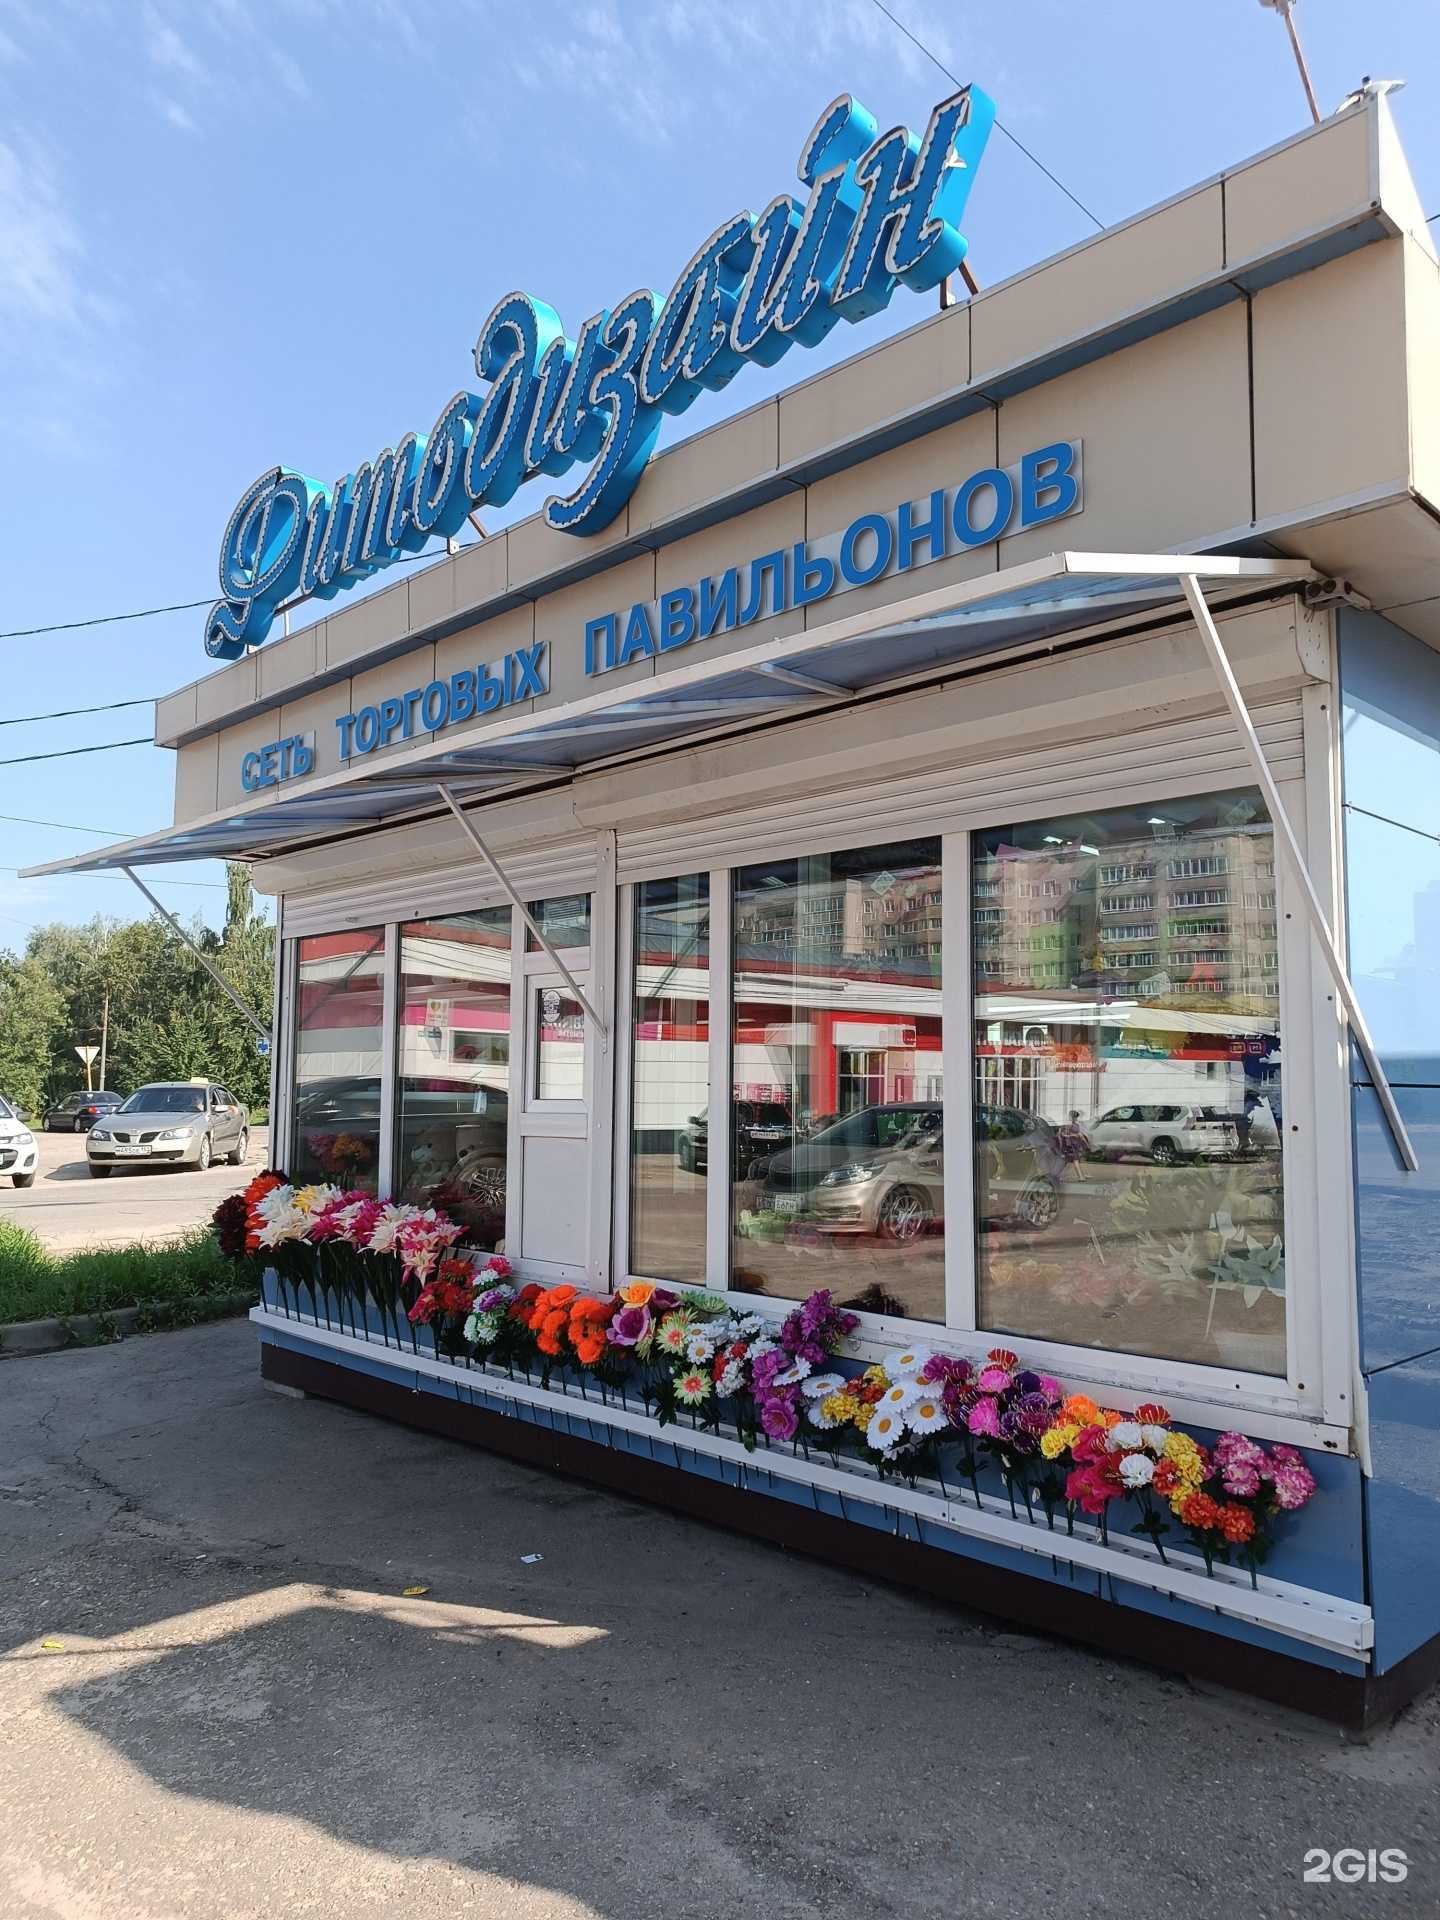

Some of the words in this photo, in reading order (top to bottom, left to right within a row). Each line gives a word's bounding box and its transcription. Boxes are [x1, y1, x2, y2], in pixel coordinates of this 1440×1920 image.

[204, 83, 994, 661] Фитодизайн
[240, 733, 314, 792] СЕТЬ
[335, 640, 549, 761] ТОРГОВЫХ
[585, 440, 1079, 677] ПАВИЛЬОНОВ
